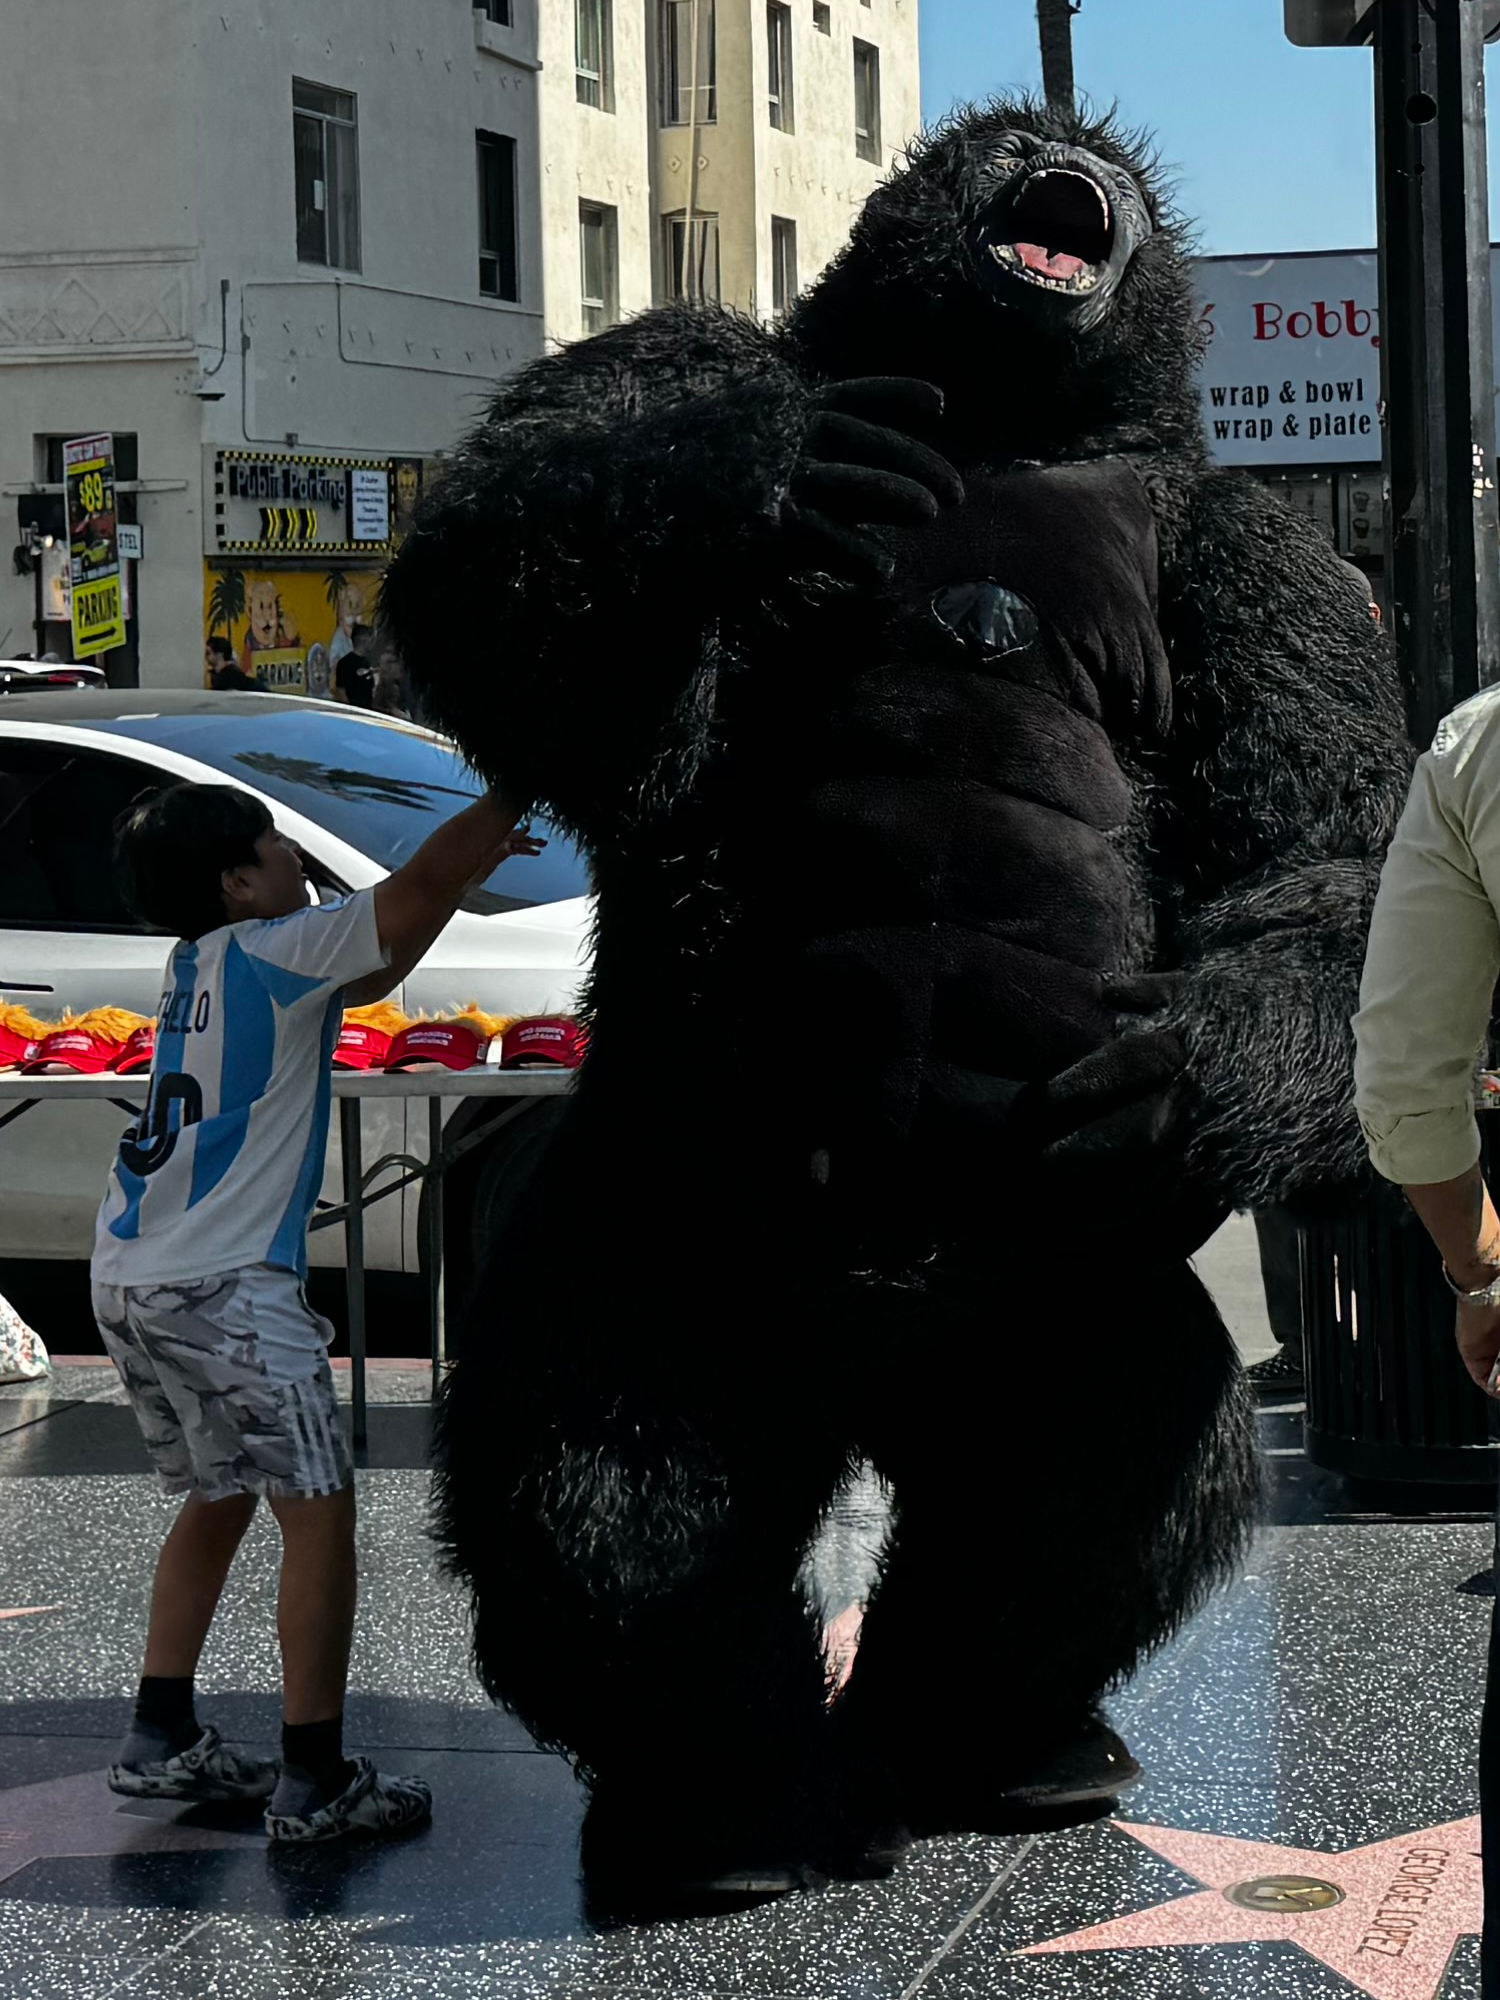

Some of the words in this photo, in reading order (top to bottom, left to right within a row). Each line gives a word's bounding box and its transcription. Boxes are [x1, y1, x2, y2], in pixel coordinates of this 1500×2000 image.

[1210, 384, 1270, 408] wrap
[1279, 380, 1296, 404] &
[1305, 378, 1364, 404] bowl
[1213, 418, 1273, 441] wrap
[1282, 413, 1300, 437] &
[1309, 411, 1372, 440] plate
[79, 472, 104, 513] $89
[289, 466, 347, 507] Parking
[77, 585, 118, 630] PARKING
[1381, 1847, 1451, 1905] GEORGE
[1354, 1909, 1423, 1958] LOPEZ
